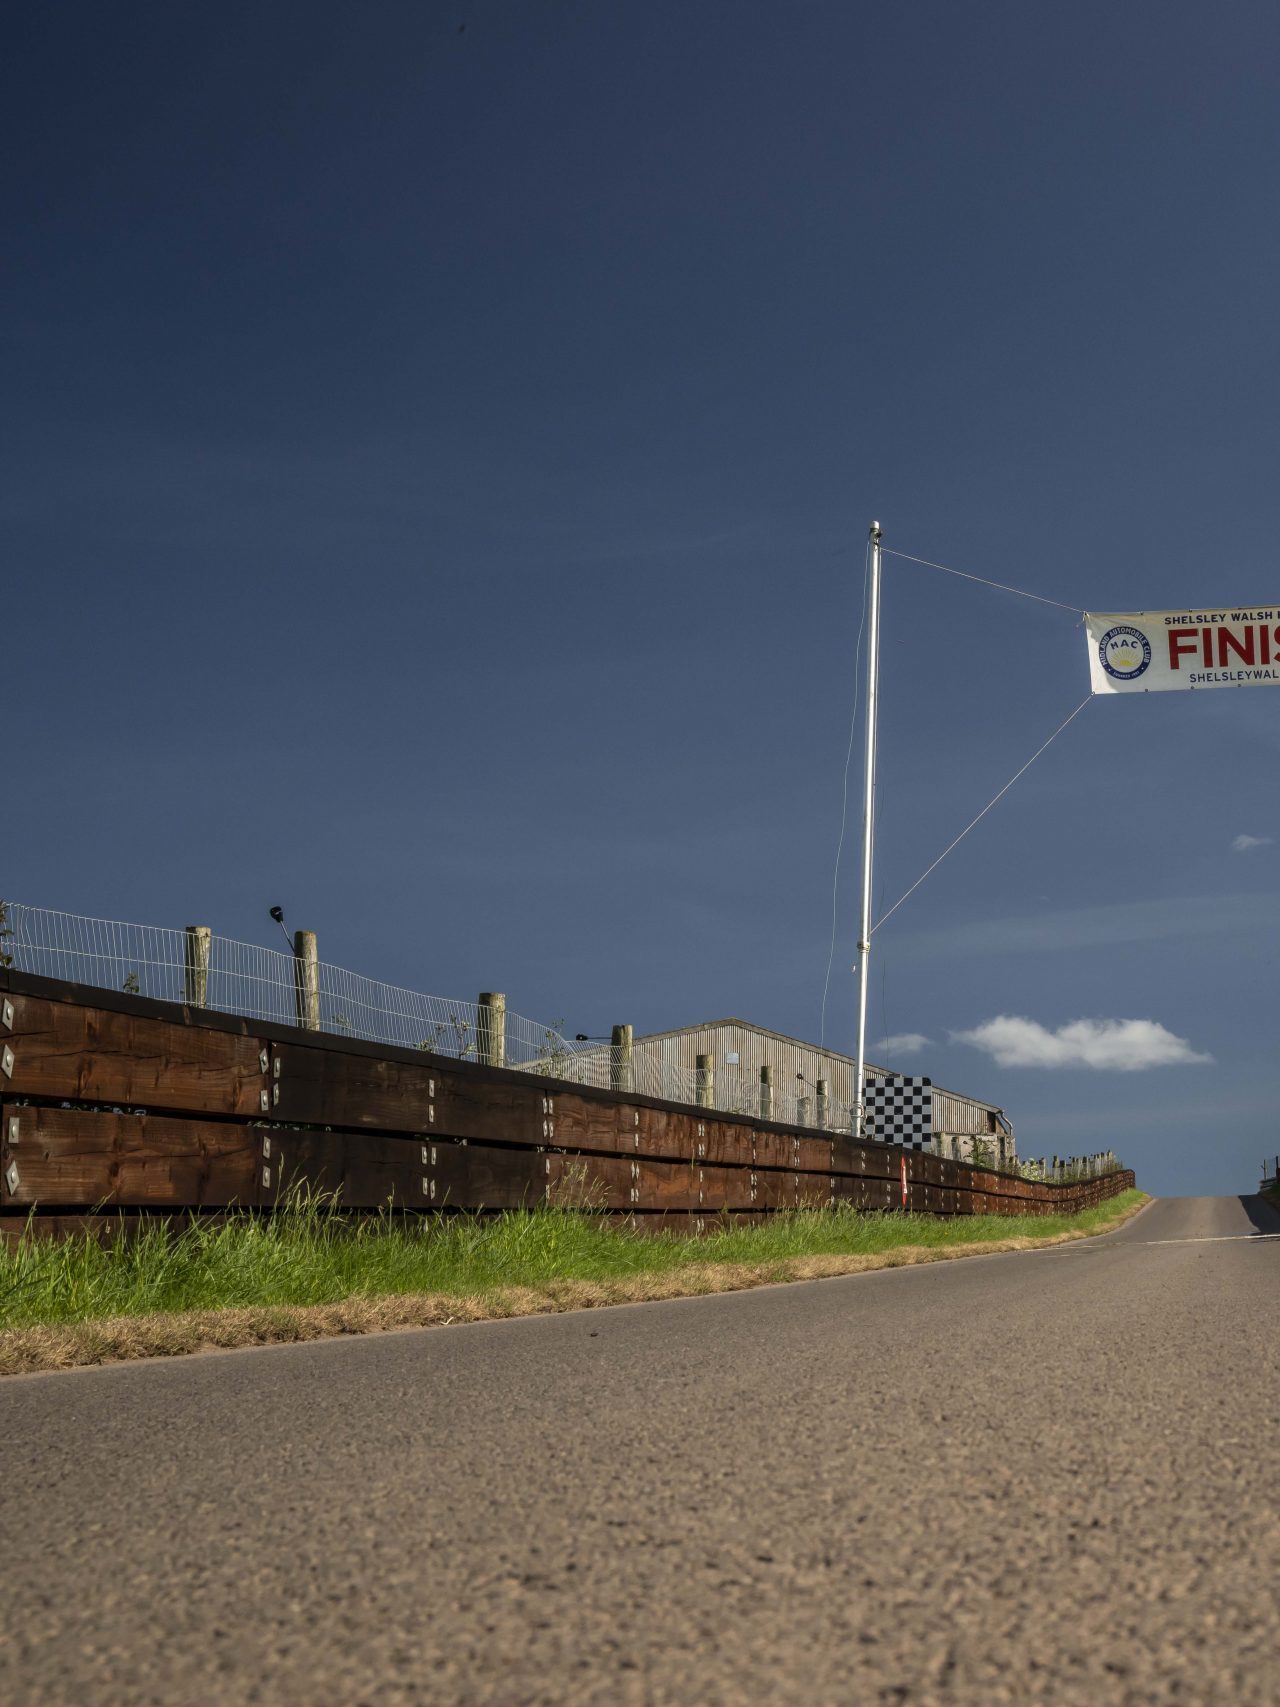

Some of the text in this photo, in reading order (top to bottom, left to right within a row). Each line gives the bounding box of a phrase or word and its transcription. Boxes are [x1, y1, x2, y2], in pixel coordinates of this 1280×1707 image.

[1164, 614, 1227, 625] SHELSLEY
[1231, 611, 1273, 621] WALSH
[1099, 635, 1110, 666] MIDLAND
[1109, 627, 1147, 645] AUTOMOBILE
[1110, 639, 1138, 650] MAC
